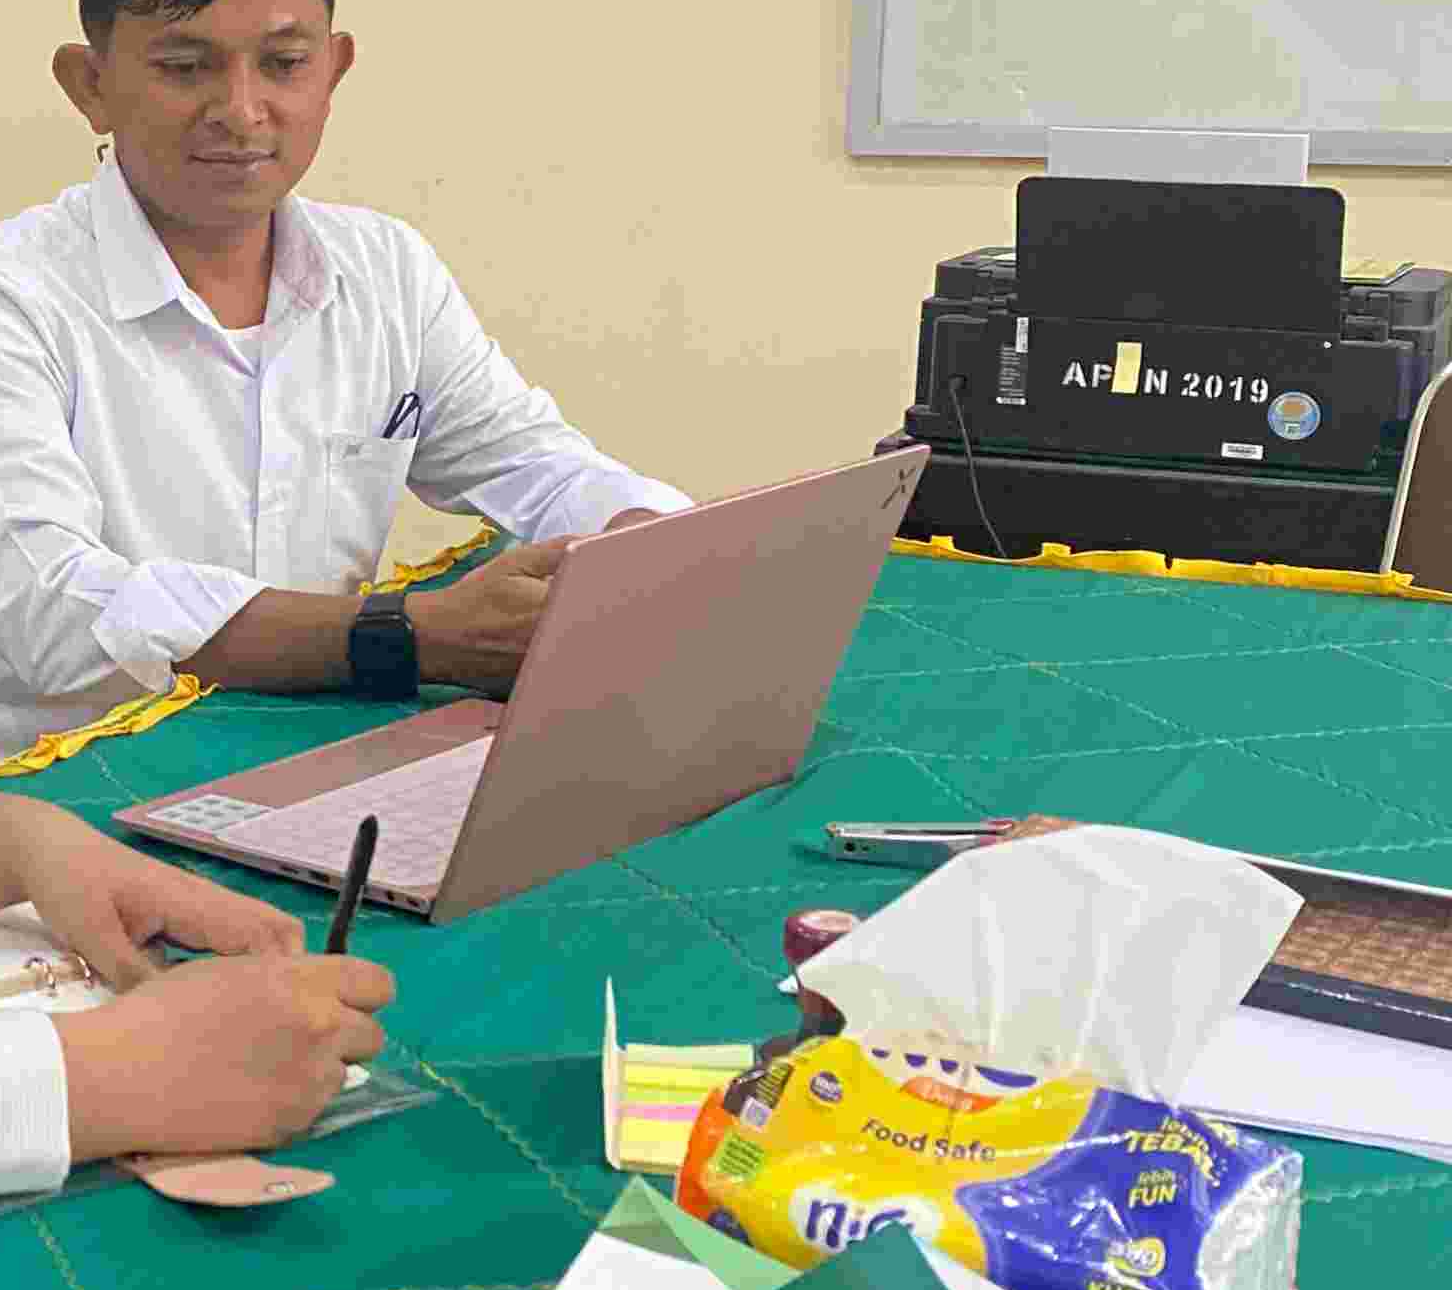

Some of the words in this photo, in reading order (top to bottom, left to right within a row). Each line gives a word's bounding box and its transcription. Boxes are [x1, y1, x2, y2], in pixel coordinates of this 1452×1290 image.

[1061, 361, 1169, 395] APN
[1180, 371, 1270, 403] 2019
[860, 1117, 928, 1153] Food
[934, 1134, 997, 1162] Safe
[1127, 1186, 1178, 1208] FUN
